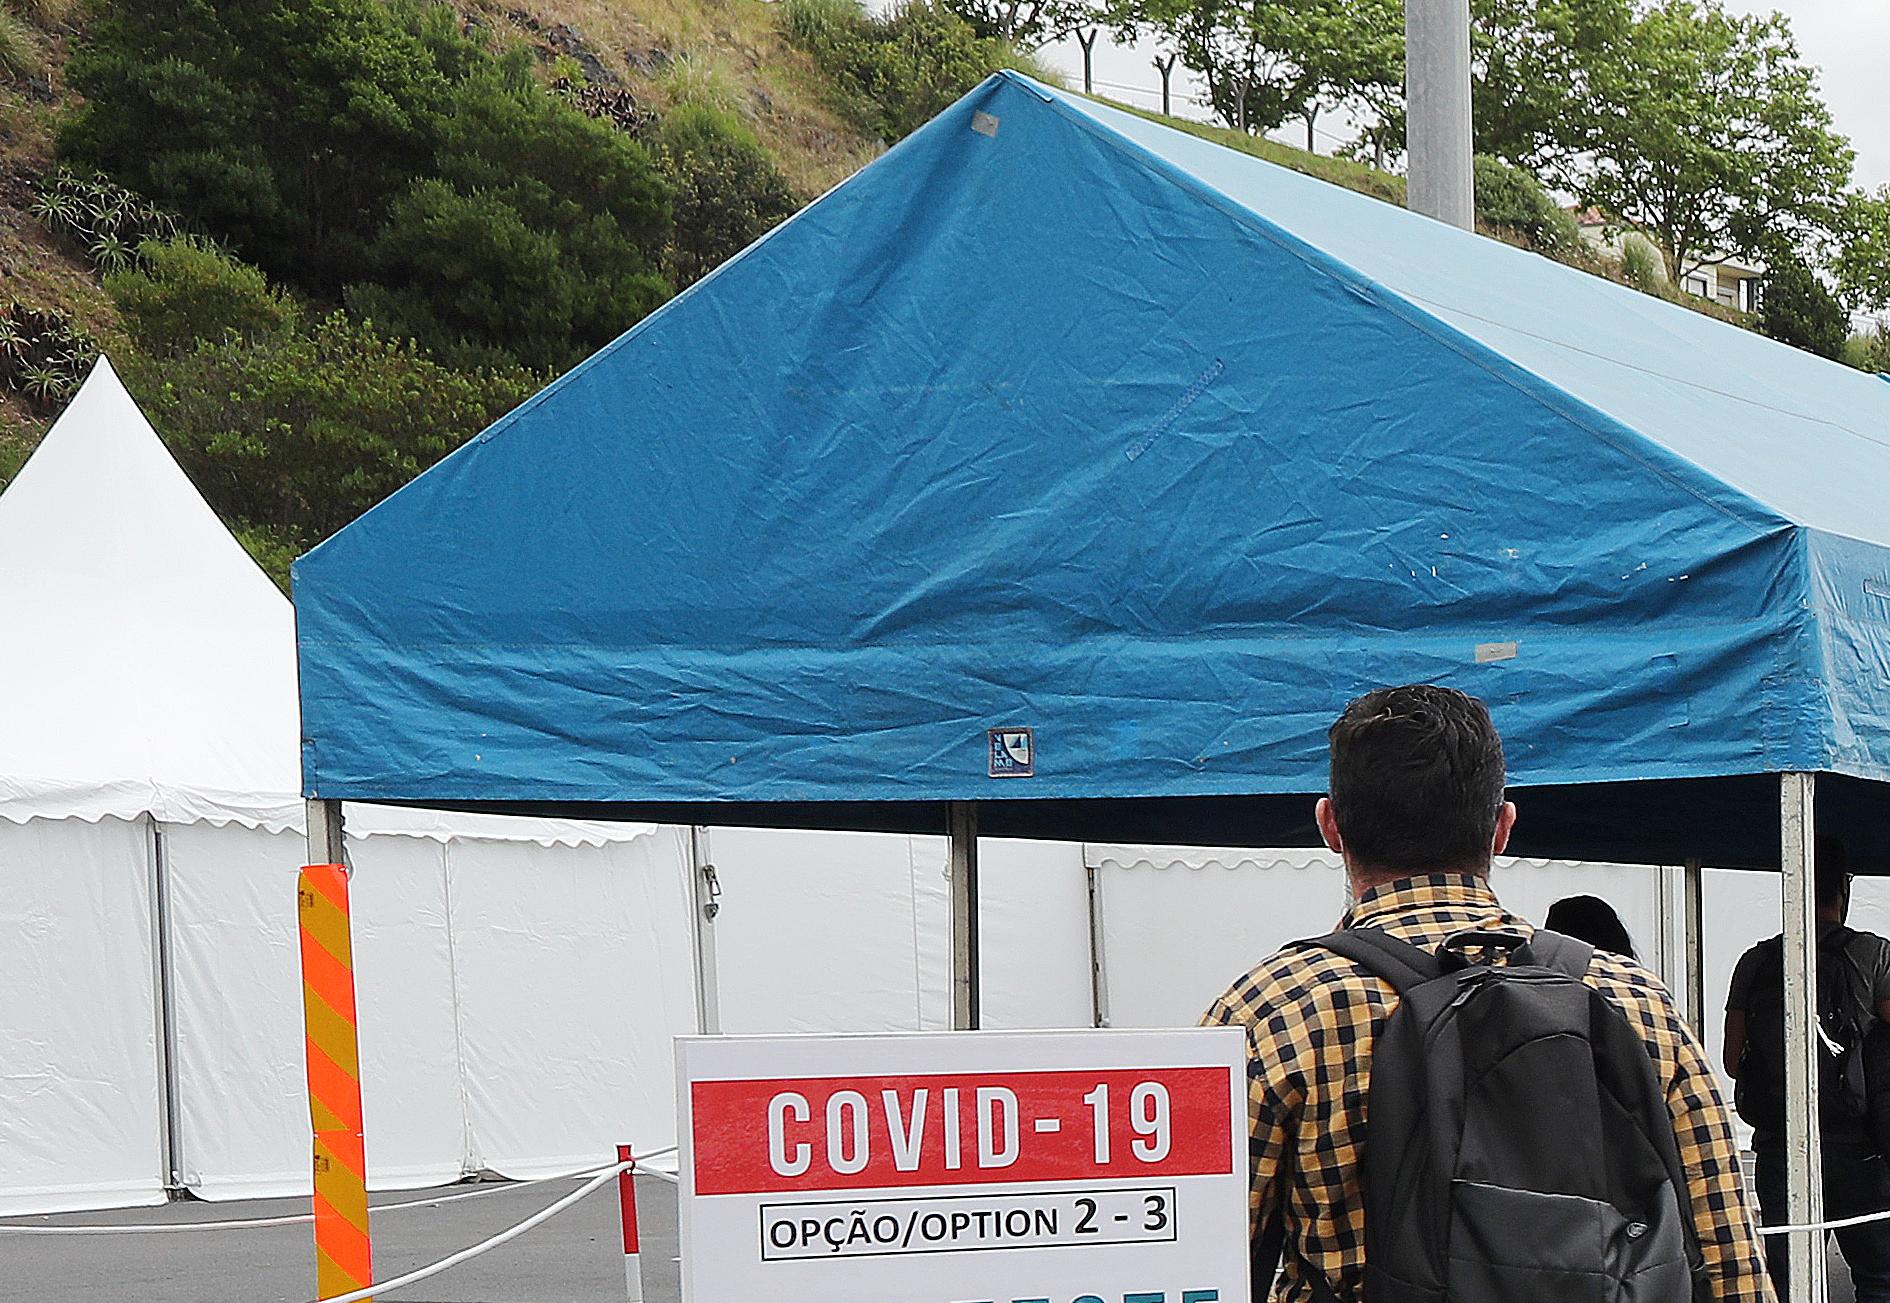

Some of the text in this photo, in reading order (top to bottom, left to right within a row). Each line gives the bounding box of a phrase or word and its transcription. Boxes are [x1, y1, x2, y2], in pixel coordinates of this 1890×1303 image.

[766, 1081, 1173, 1178] COVID-19
[769, 1207, 1059, 1253] OPÇÃO/OPTION
[1074, 1198, 1099, 1234] 2
[1143, 1195, 1168, 1231] 3
